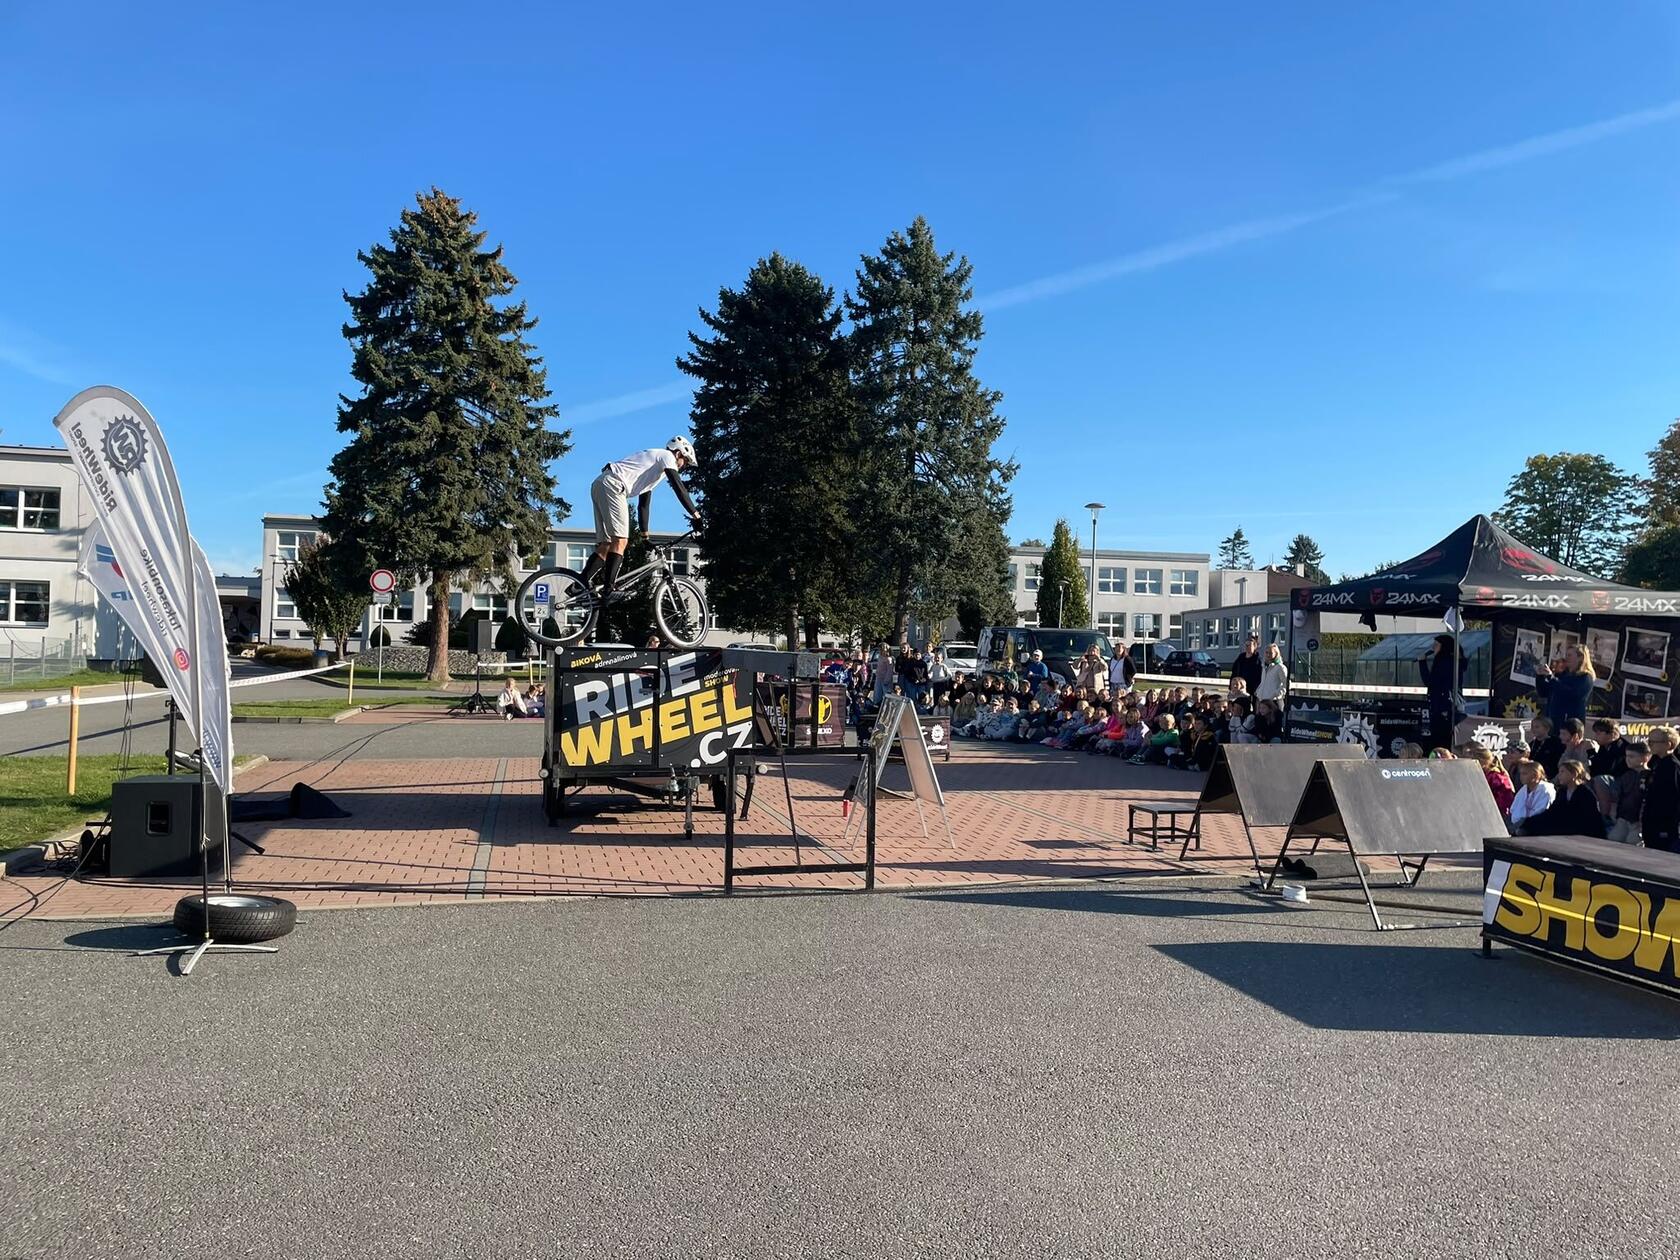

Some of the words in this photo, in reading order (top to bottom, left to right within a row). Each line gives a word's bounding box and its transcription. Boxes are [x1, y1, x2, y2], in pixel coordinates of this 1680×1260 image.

[537, 585, 546, 598] P
[1312, 592, 1355, 606] 24MX
[1385, 593, 1441, 604] 24MX
[1502, 594, 1571, 609] 24MX
[1614, 597, 1679, 612] 24MX
[570, 652, 602, 669] BIKOVÁ
[594, 651, 638, 669] adrenalinová
[573, 652, 701, 726] RIDE
[704, 675, 729, 688] SHOW
[561, 684, 753, 767] WHEEL
[1391, 769, 1431, 778] centropen
[1495, 863, 1680, 978] SHOW
